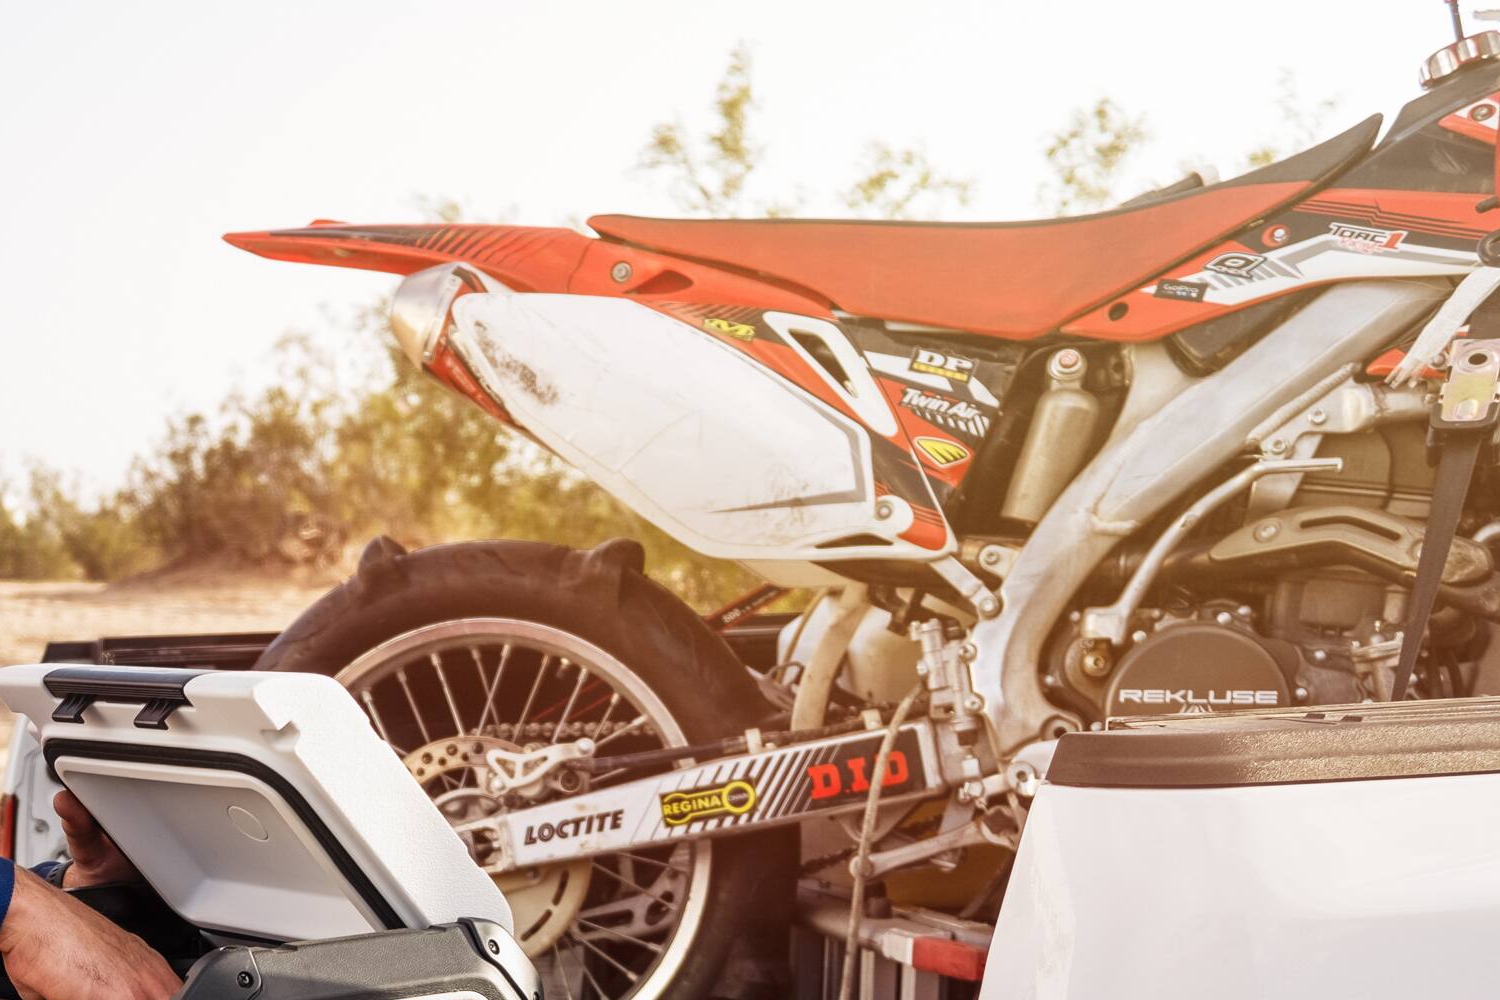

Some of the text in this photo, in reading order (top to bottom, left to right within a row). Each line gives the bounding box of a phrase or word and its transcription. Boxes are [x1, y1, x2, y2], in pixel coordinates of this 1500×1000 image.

[915, 349, 973, 371] DP
[902, 387, 983, 420] Twin Air
[1119, 688, 1279, 705] REKLUSE
[663, 795, 721, 816] REGINA
[523, 808, 625, 846] LOCTITE
